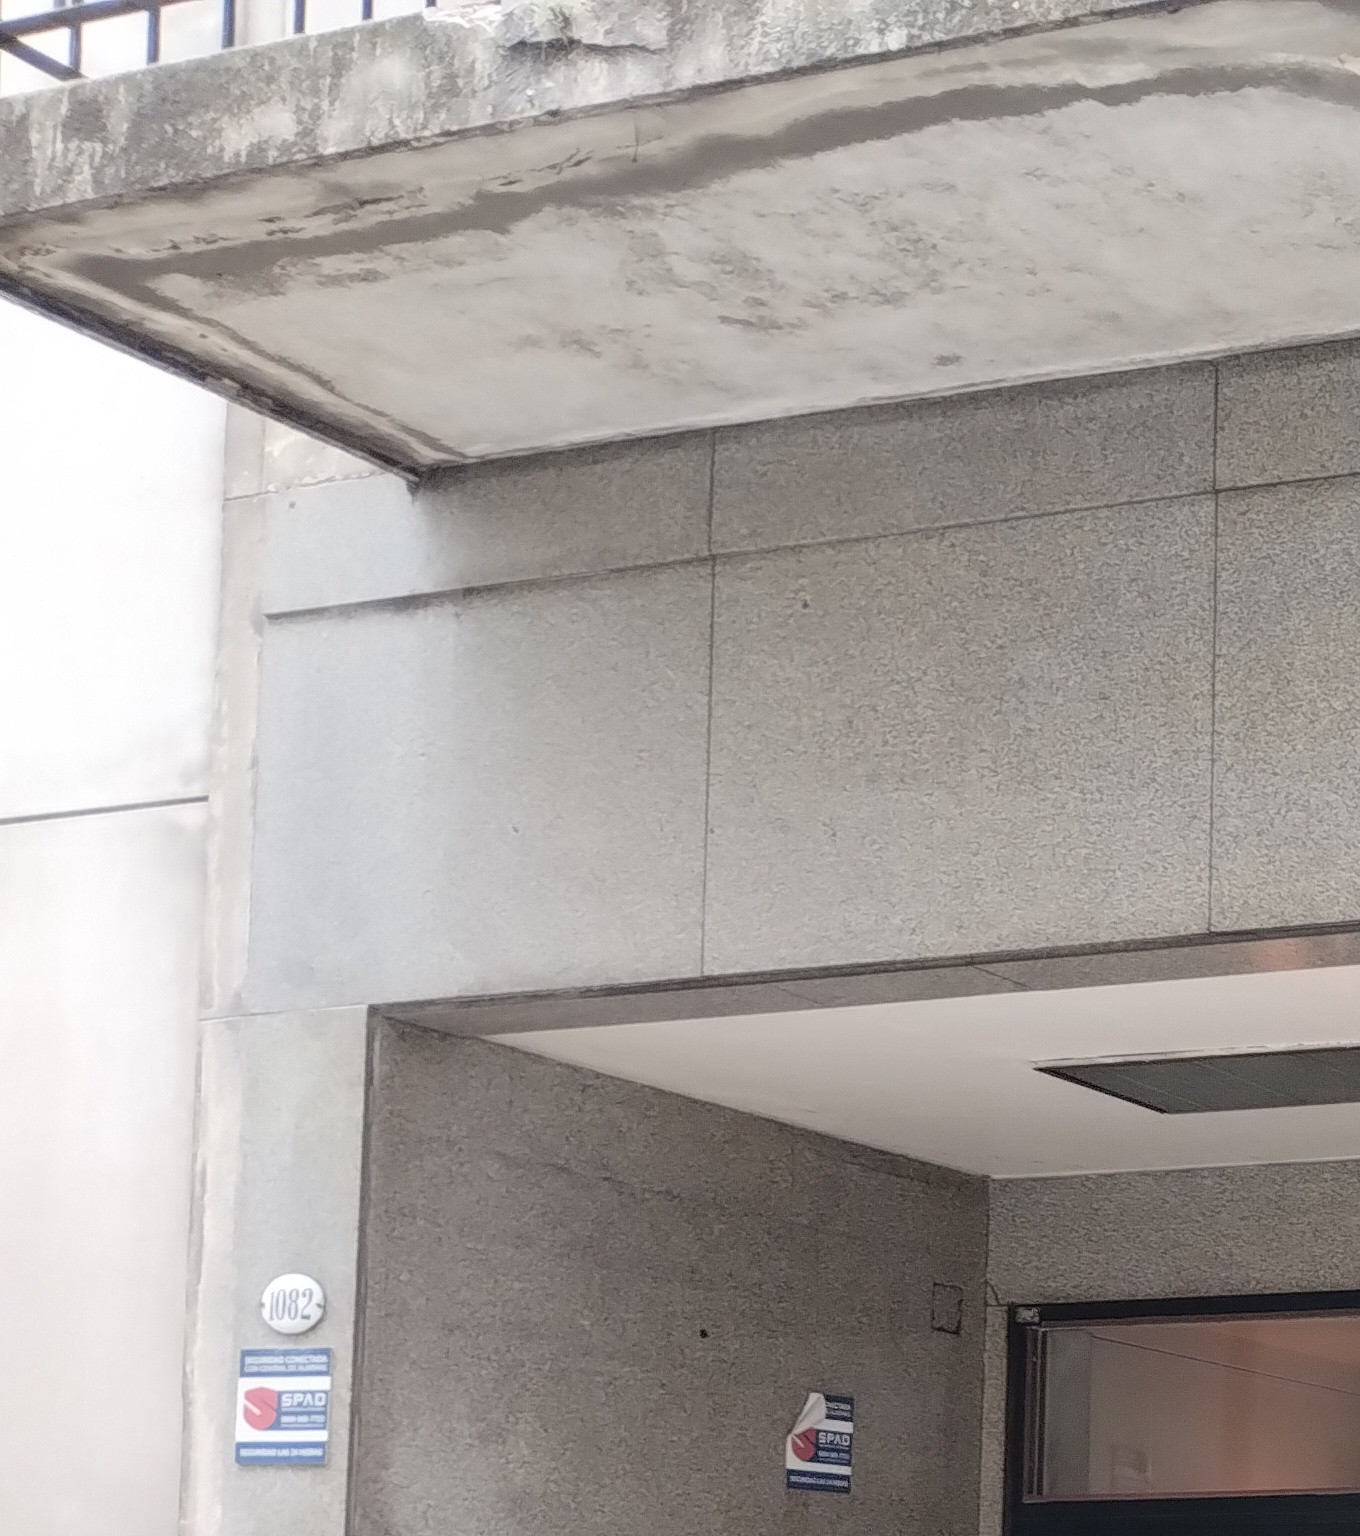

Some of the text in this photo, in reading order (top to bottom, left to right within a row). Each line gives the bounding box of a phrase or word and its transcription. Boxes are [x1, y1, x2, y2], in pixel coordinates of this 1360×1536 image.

[268, 1287, 314, 1321] 1082
[281, 1392, 327, 1407] SPAD
[818, 1432, 850, 1446] SPAD
